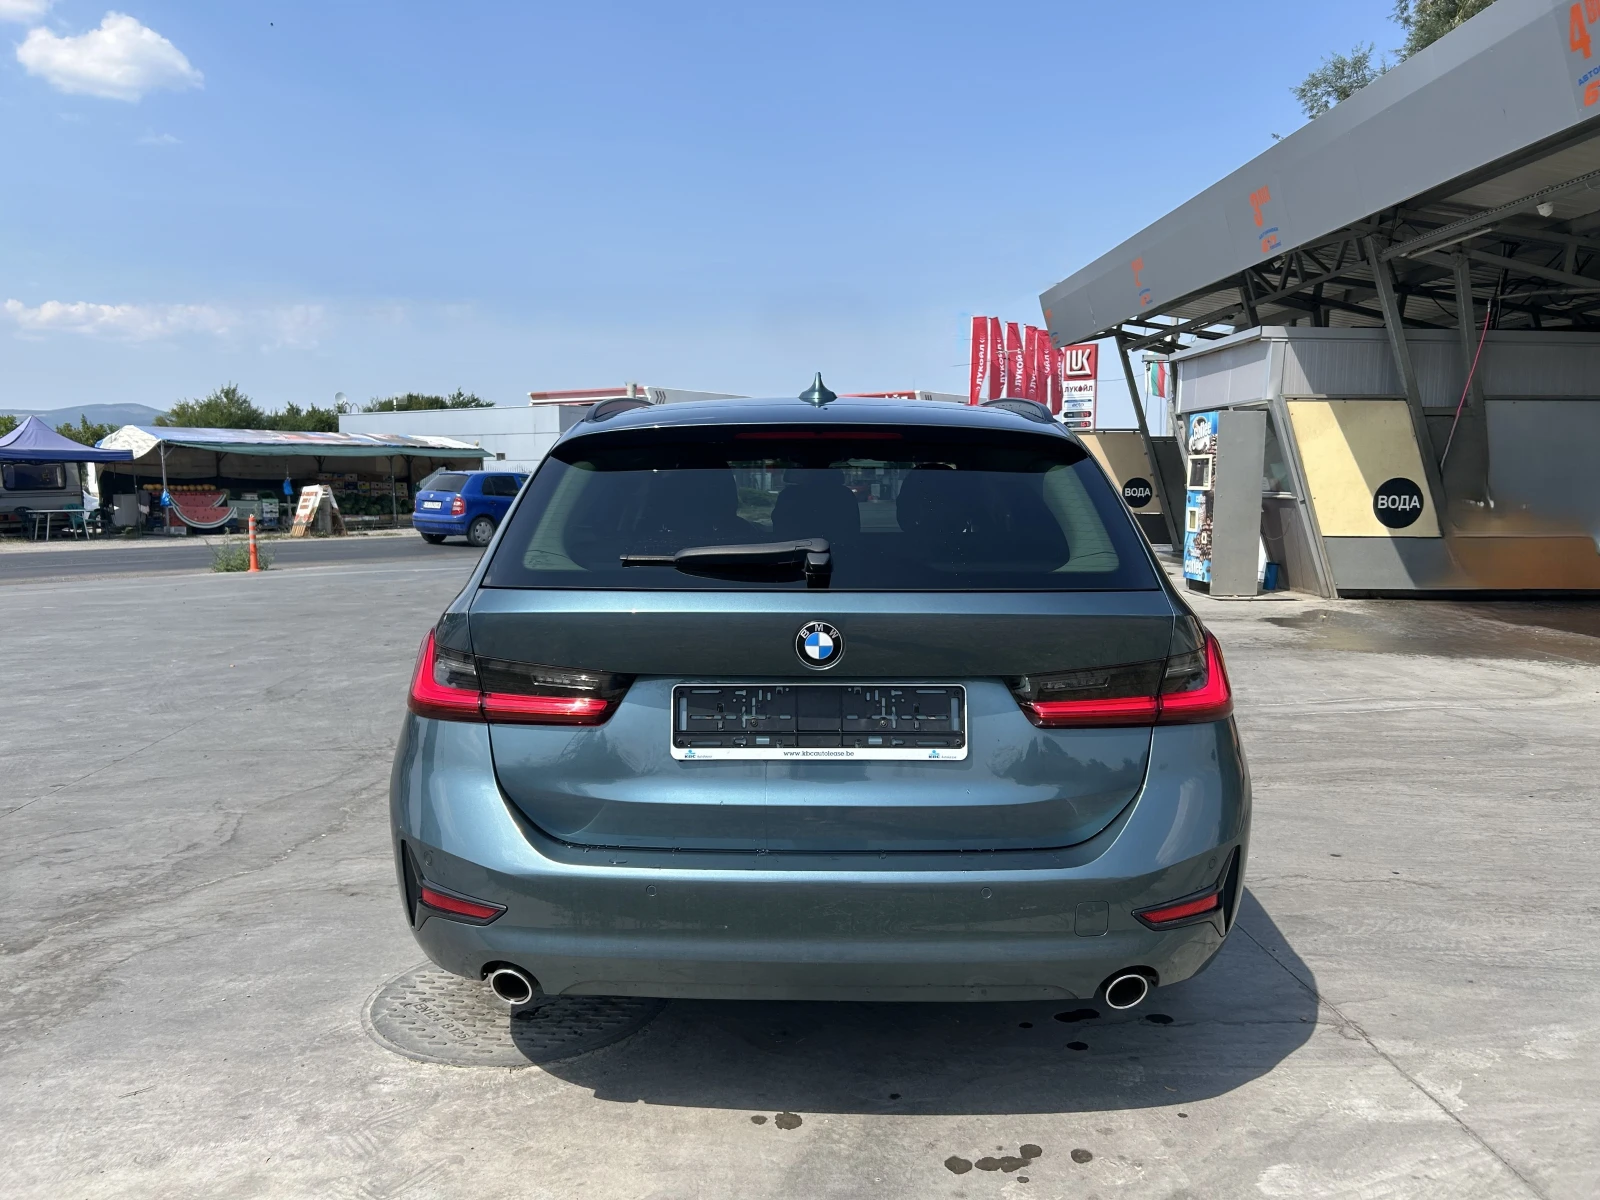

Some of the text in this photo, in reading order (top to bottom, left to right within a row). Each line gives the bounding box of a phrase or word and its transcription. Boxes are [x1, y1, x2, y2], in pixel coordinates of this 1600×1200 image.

[976, 344, 986, 386] ЛУКОЙЛ
[1124, 487, 1151, 498] ВОДА
[1377, 495, 1421, 512] ВОДА
[800, 623, 839, 639] BMW
